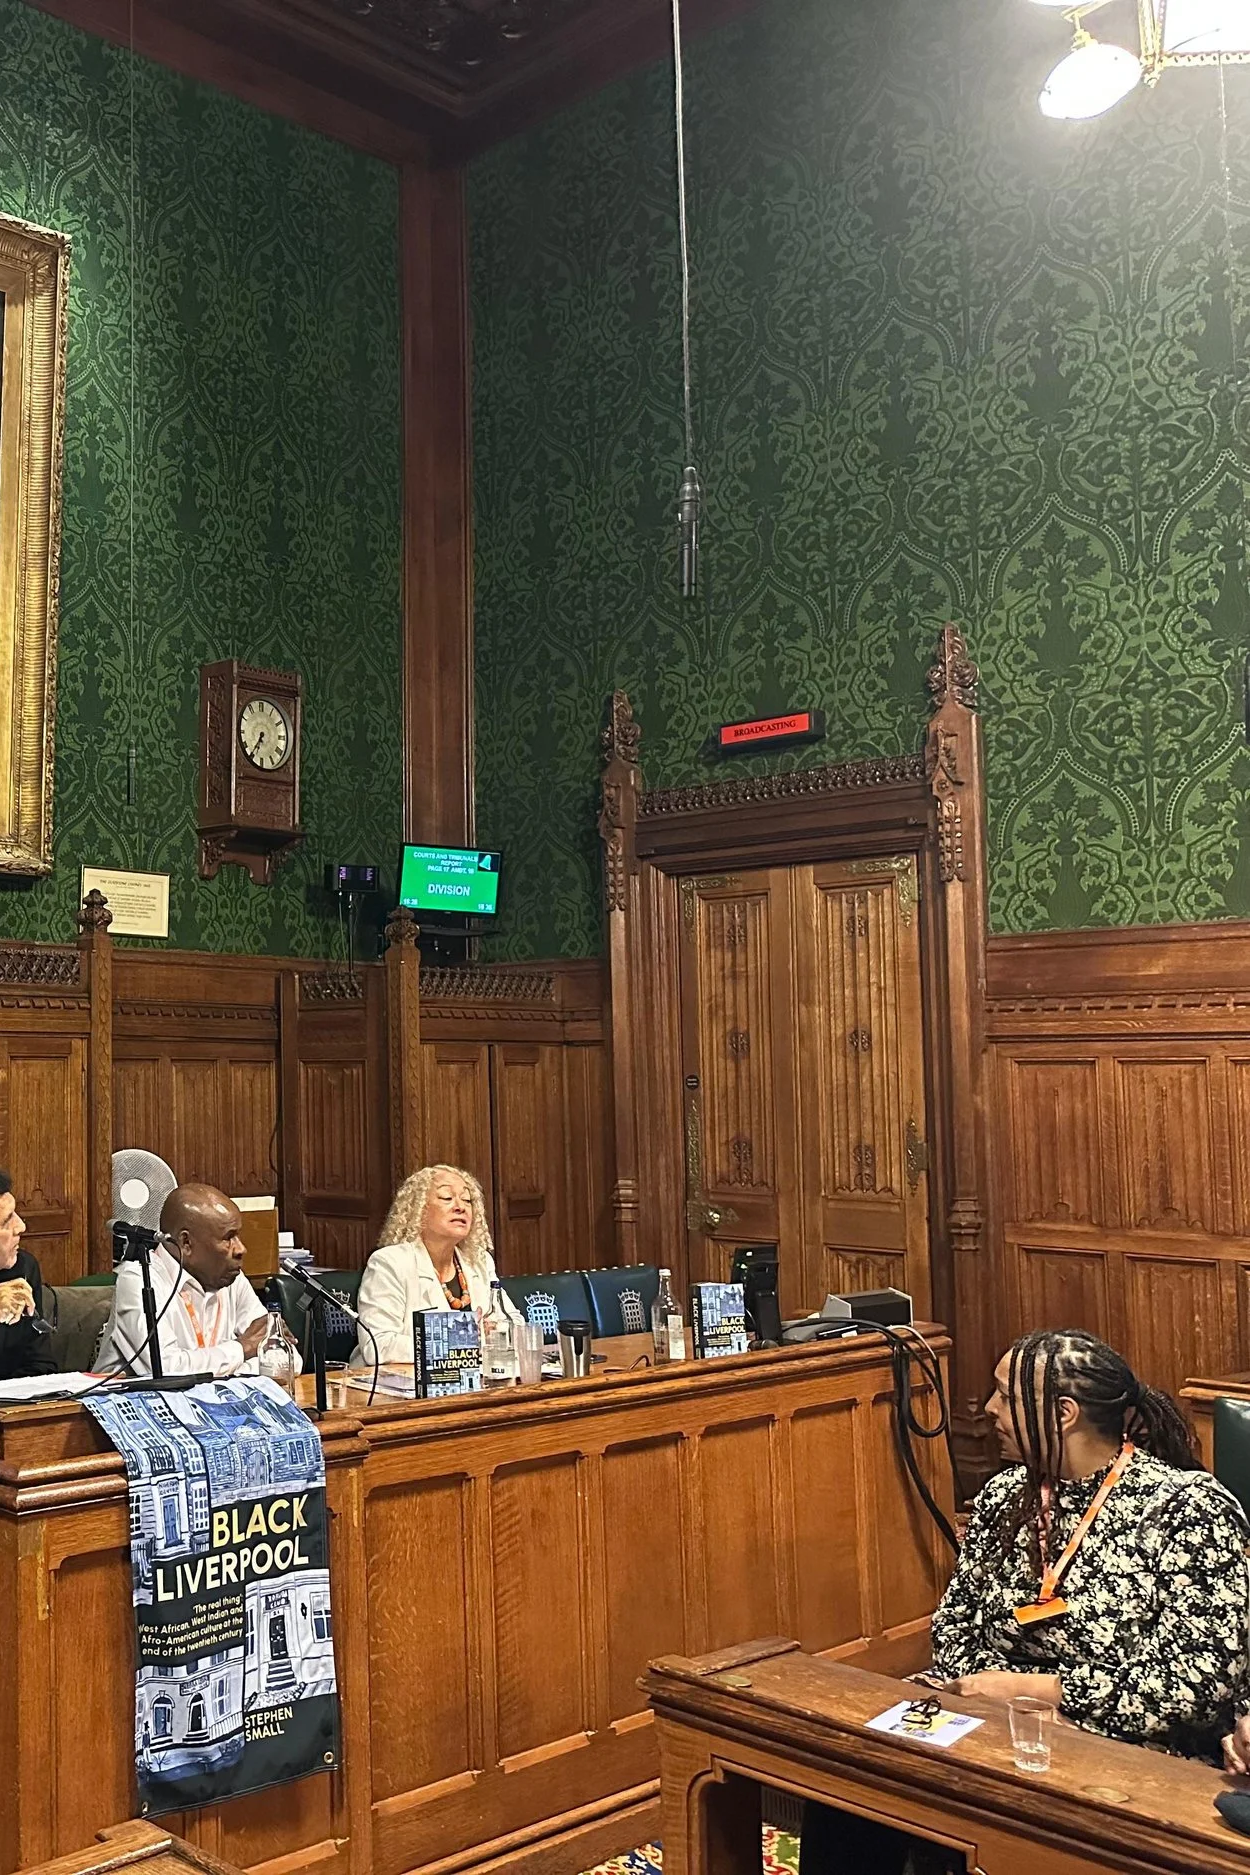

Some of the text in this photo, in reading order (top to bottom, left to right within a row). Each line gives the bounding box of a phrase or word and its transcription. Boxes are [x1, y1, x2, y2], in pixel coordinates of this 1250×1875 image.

[734, 719, 796, 737] BROADCASTING
[413, 851, 435, 859] COURTS
[427, 884, 471, 896] DIVISION
[710, 1326, 746, 1334] LIVERPOOL
[721, 1317, 745, 1326] BLACK
[450, 1349, 479, 1359] BLACK
[433, 1359, 479, 1369] LIVERPOOL
[212, 1494, 309, 1548] BLACK
[156, 1535, 309, 1602] LIVERPOOL
[208, 1600, 222, 1610] real
[138, 1624, 159, 1634] West
[191, 1615, 207, 1627] West
[207, 1608, 229, 1620] Indian
[230, 1603, 244, 1614] and
[141, 1616, 244, 1645] Afro-American culture at the
[142, 1628, 243, 1656] end of the twentieth century
[244, 1706, 293, 1729] STEPHEN
[245, 1722, 285, 1742] SMALL
